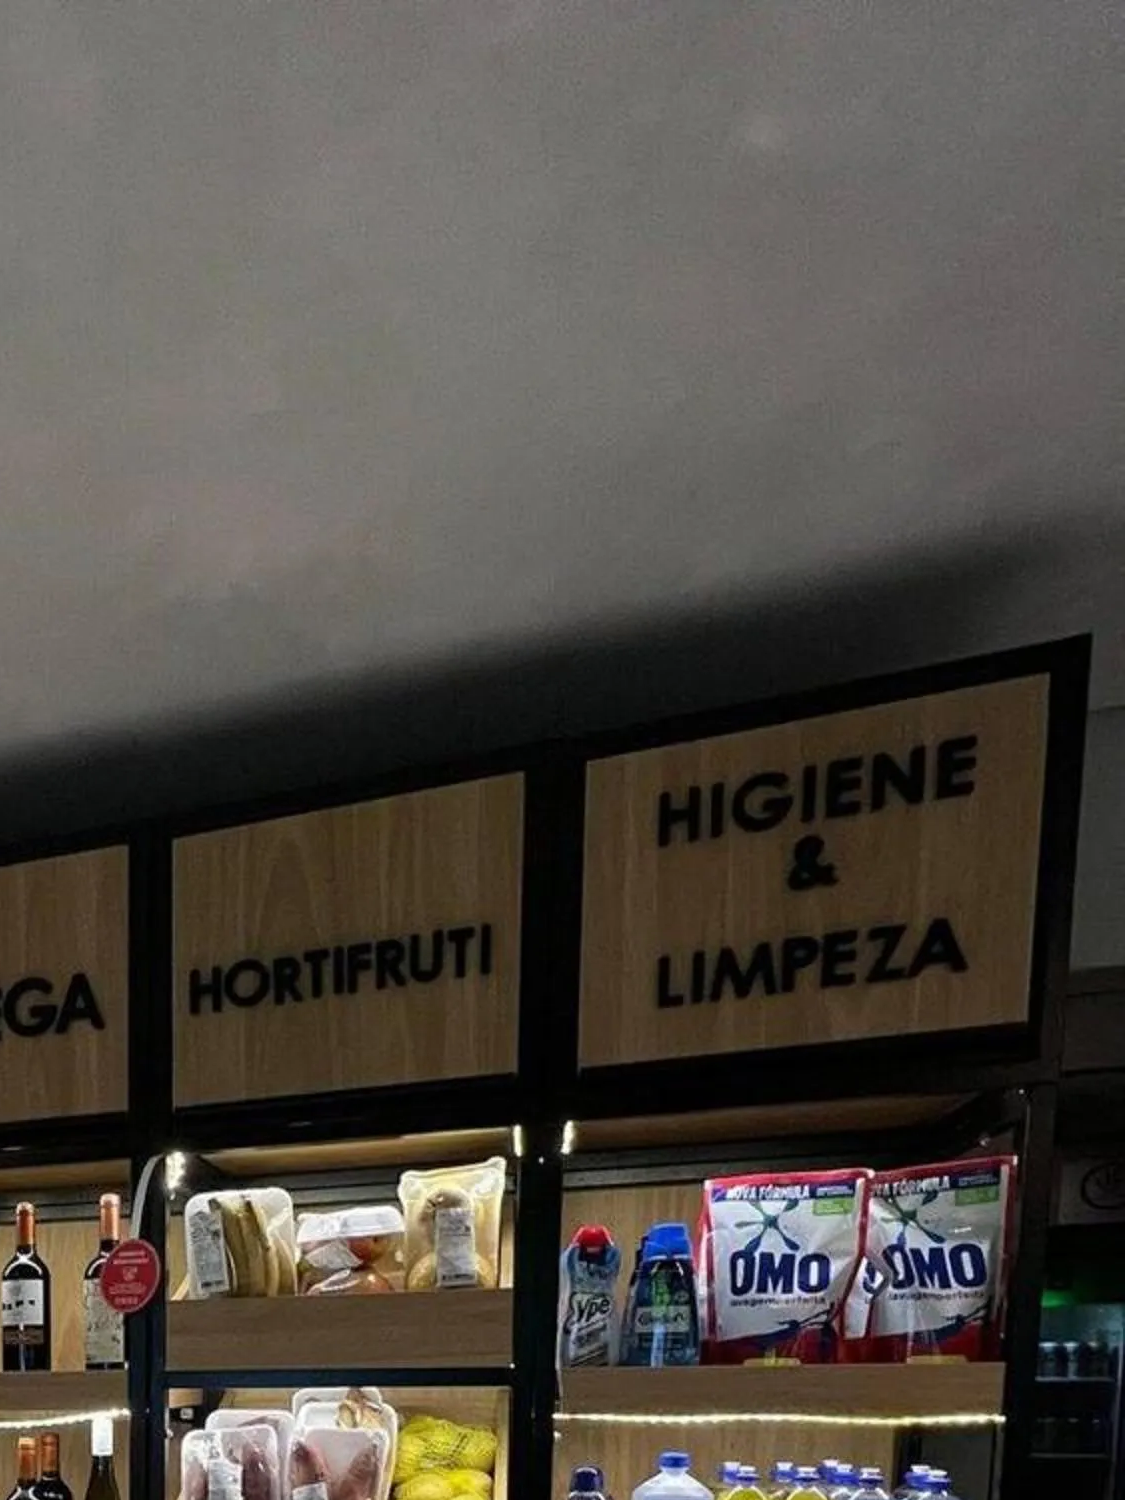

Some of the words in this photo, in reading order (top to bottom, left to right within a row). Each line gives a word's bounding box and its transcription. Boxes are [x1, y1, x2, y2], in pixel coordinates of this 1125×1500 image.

[658, 735, 978, 847] HIGIENE
[787, 834, 839, 890] &
[189, 923, 494, 1016] HORTIFRUTI
[658, 917, 968, 1009] LIMPEZA
[729, 1250, 831, 1297] OMO
[882, 1242, 988, 1291] OMO
